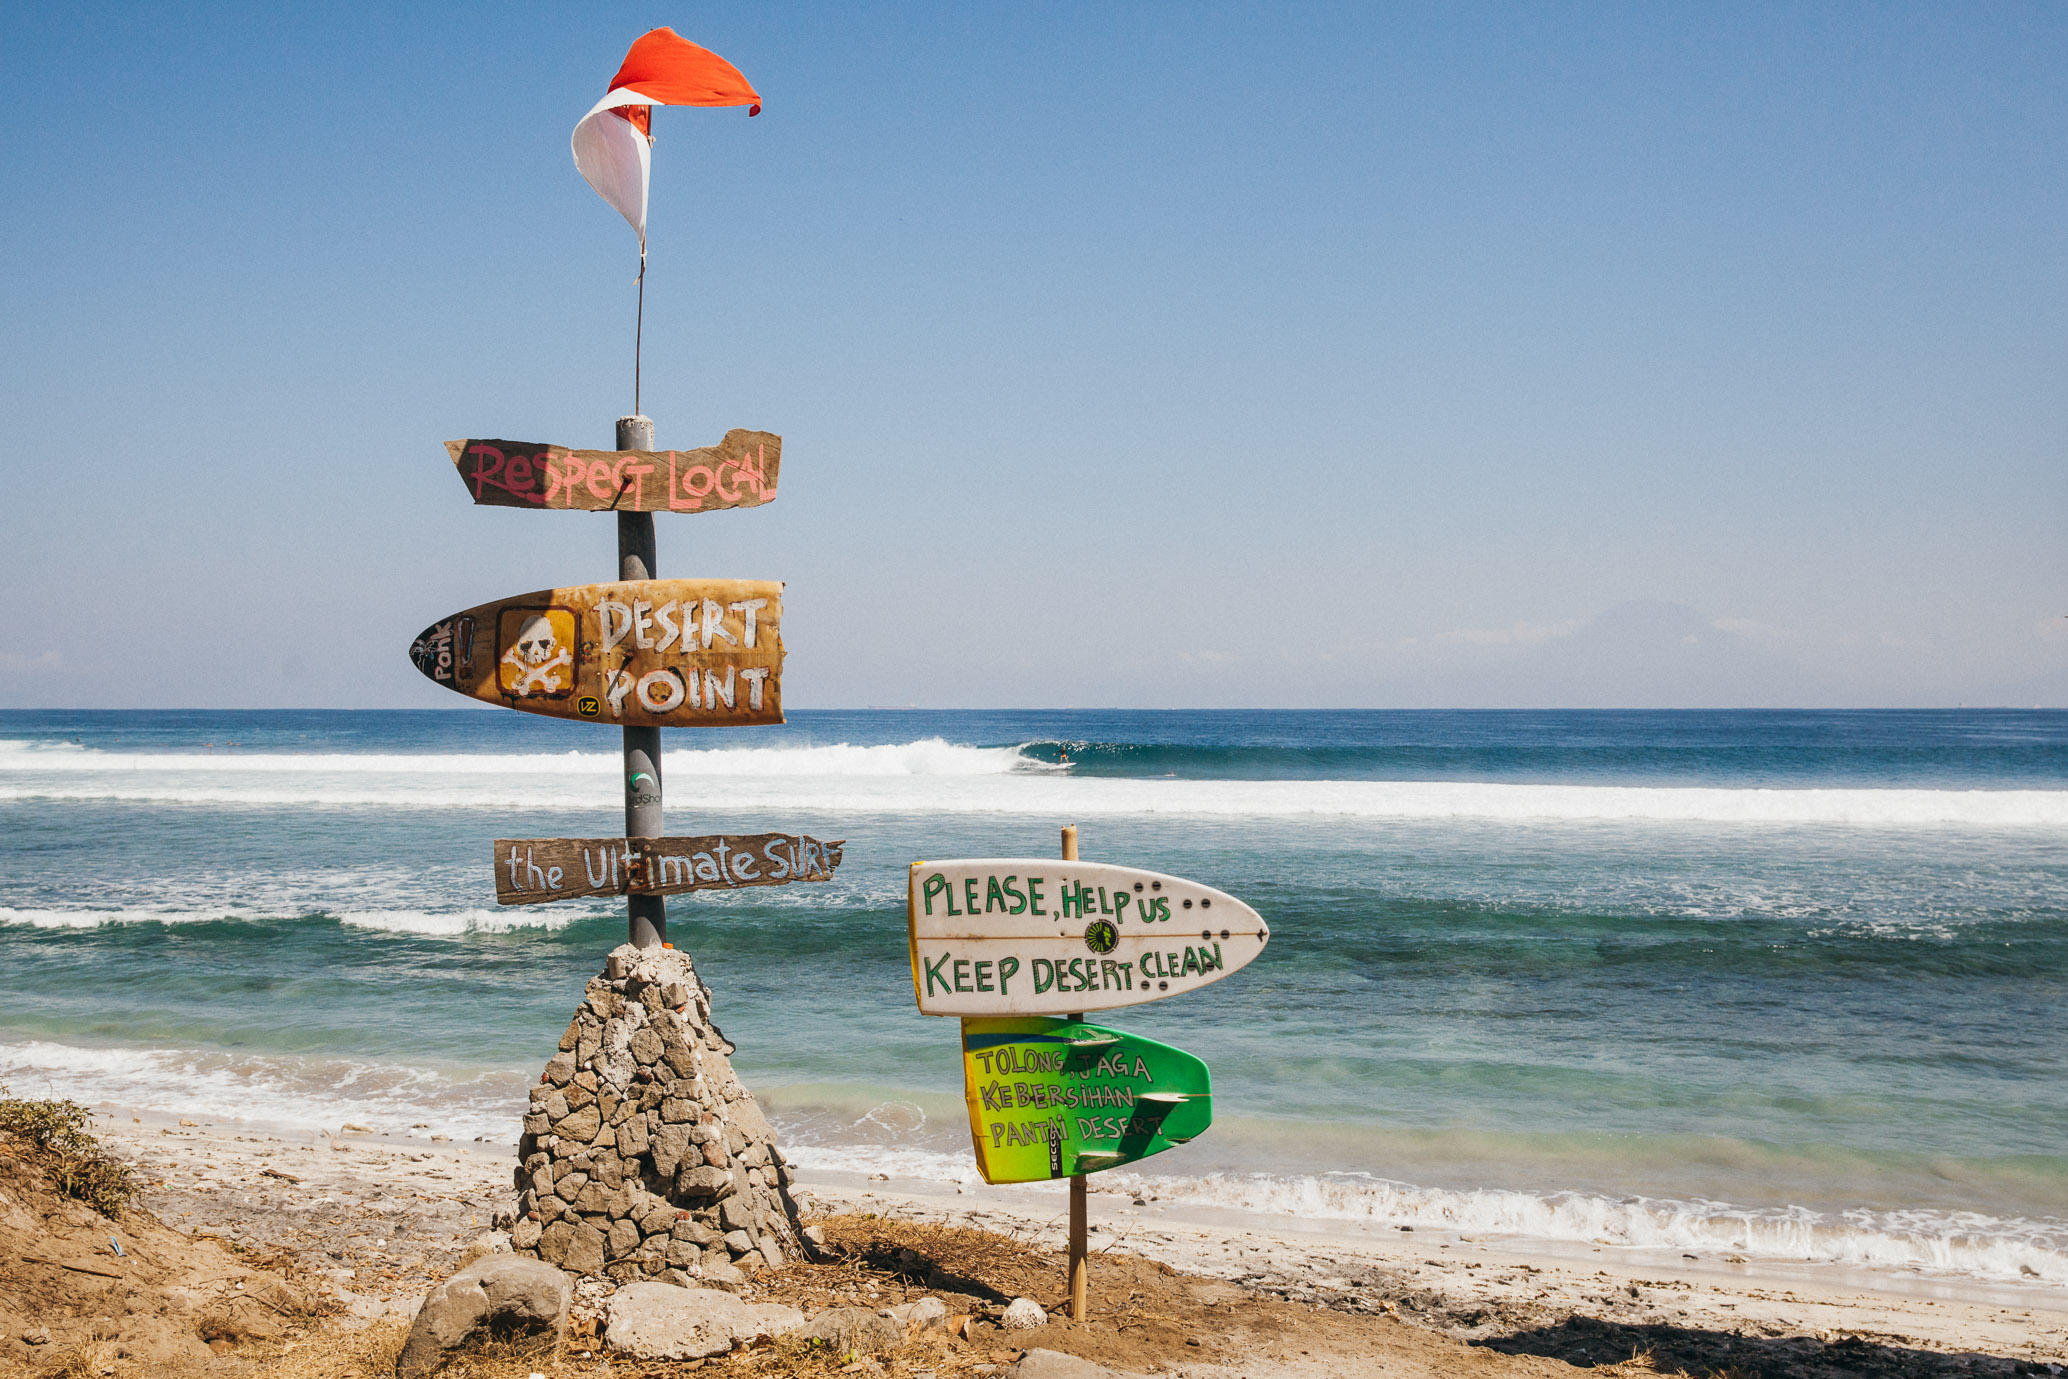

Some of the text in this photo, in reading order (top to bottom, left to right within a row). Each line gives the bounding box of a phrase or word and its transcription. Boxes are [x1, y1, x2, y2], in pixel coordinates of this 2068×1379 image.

[592, 596, 768, 654] DESERT
[604, 664, 770, 718] POINT
[505, 845, 565, 895] the
[583, 837, 761, 890] Ultimate
[922, 872, 1172, 925] PLEASE, HELP US
[923, 941, 1223, 998] KEEP DESERT CLEAN
[1078, 1052, 1153, 1083] JAGA
[1075, 1115, 1164, 1141] DESERT
